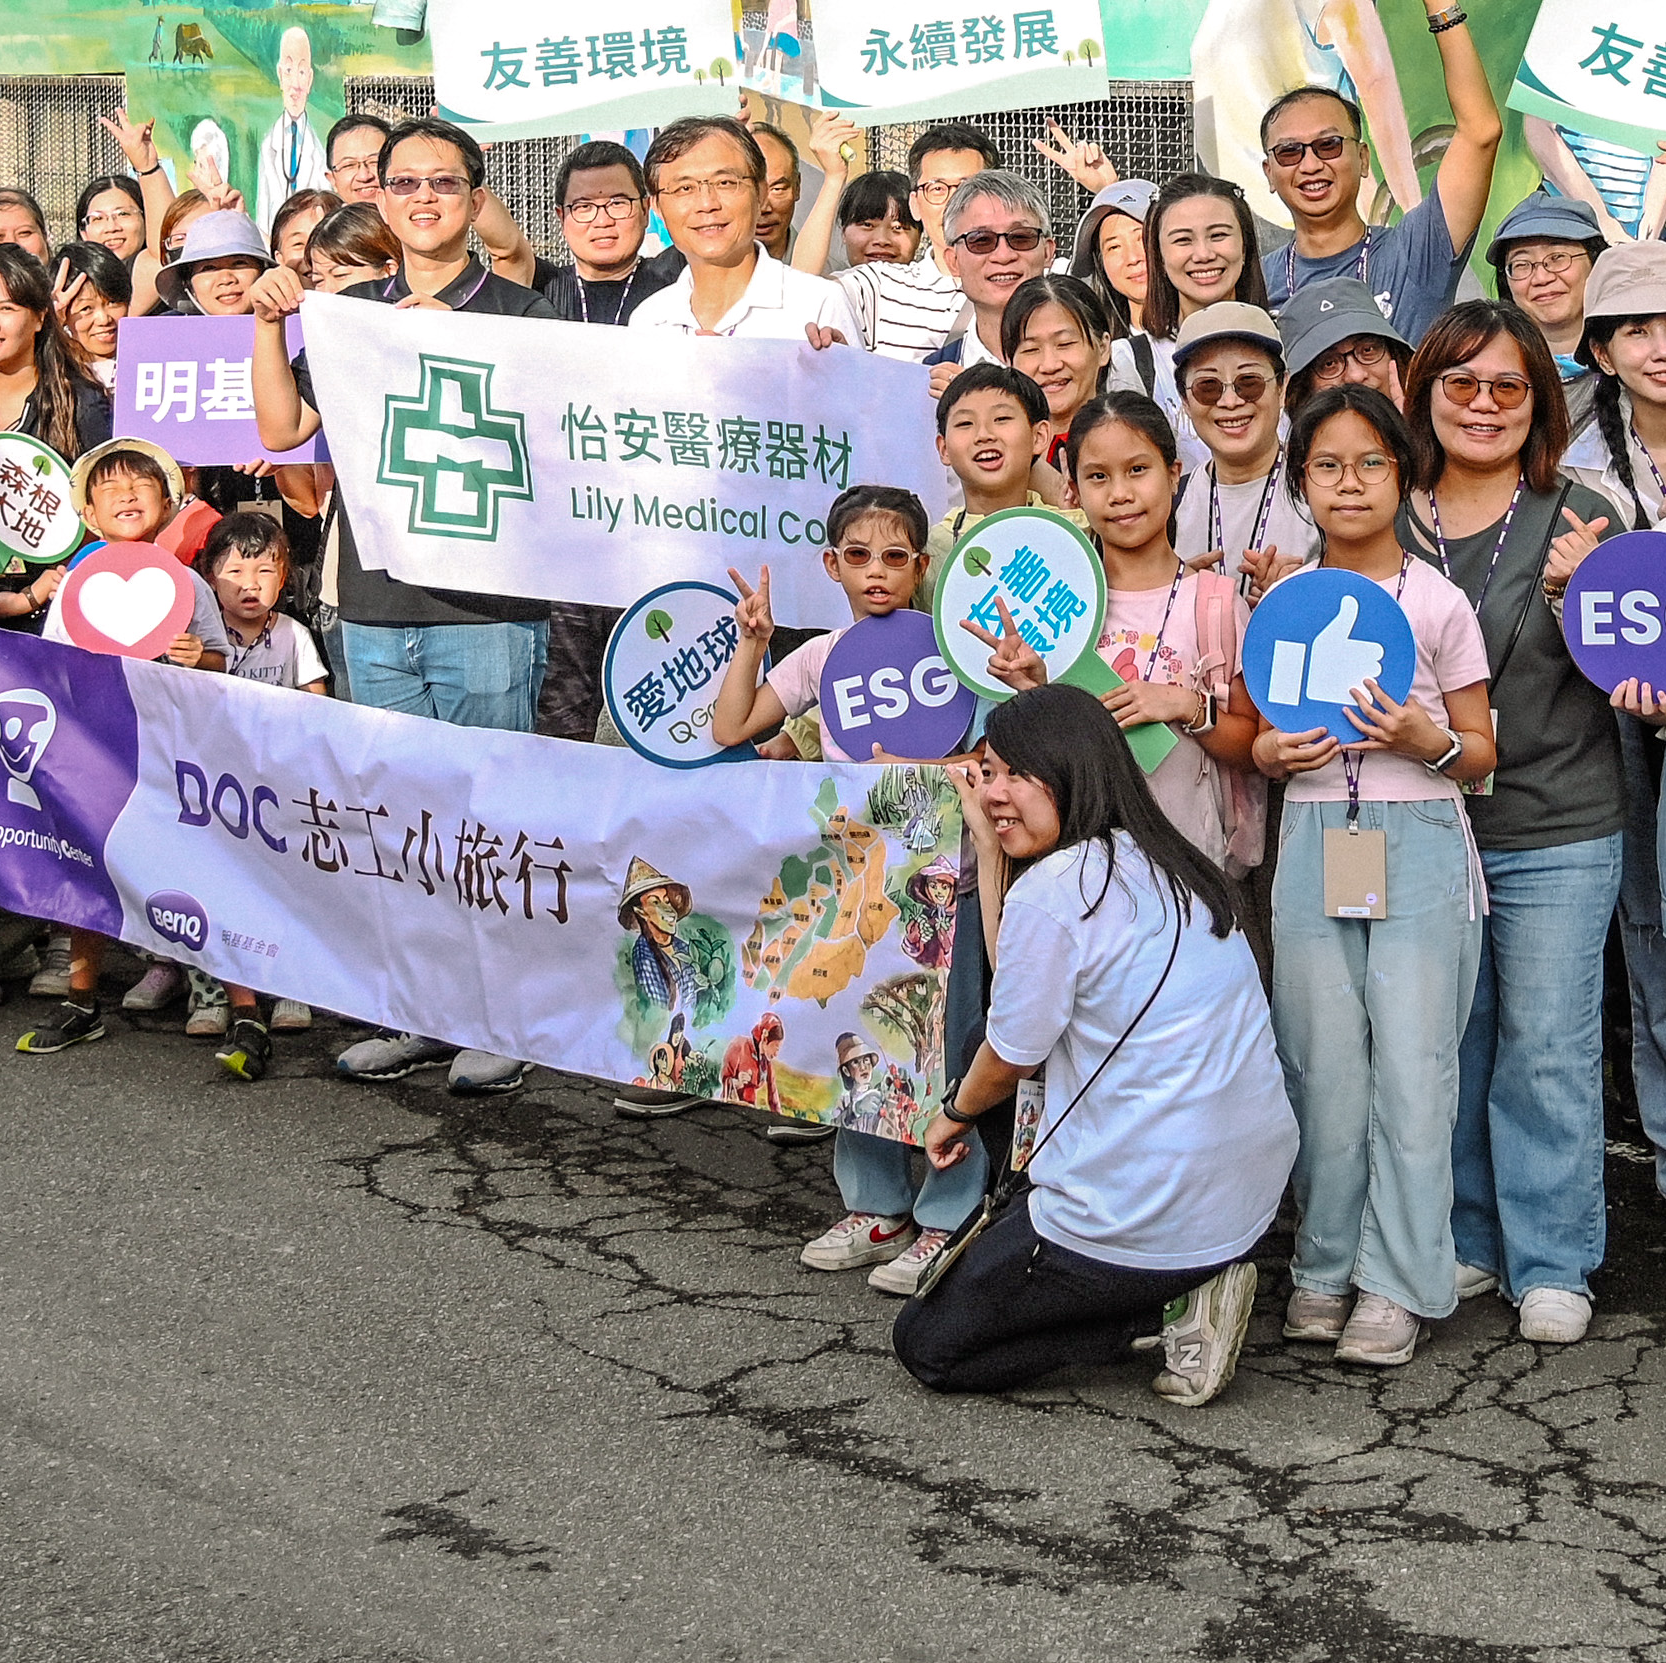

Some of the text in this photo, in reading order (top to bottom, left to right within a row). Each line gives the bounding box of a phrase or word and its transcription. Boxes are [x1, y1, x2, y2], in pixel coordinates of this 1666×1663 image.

[480, 25, 691, 91] 友善環境
[860, 9, 1059, 76] 永續發展
[135, 358, 256, 423] 明基
[561, 402, 853, 490] 怡安醫療器材
[571, 485, 624, 533] Lily
[633, 493, 767, 540] Medical
[967, 545, 1051, 638] 友善
[249, 662, 286, 679] KITTY
[623, 616, 738, 733] 愛地球
[833, 655, 958, 731] ESG
[175, 760, 573, 924] DOC 志工小旅行
[151, 907, 202, 942] BenQ
[222, 929, 280, 959] 明基基金會
